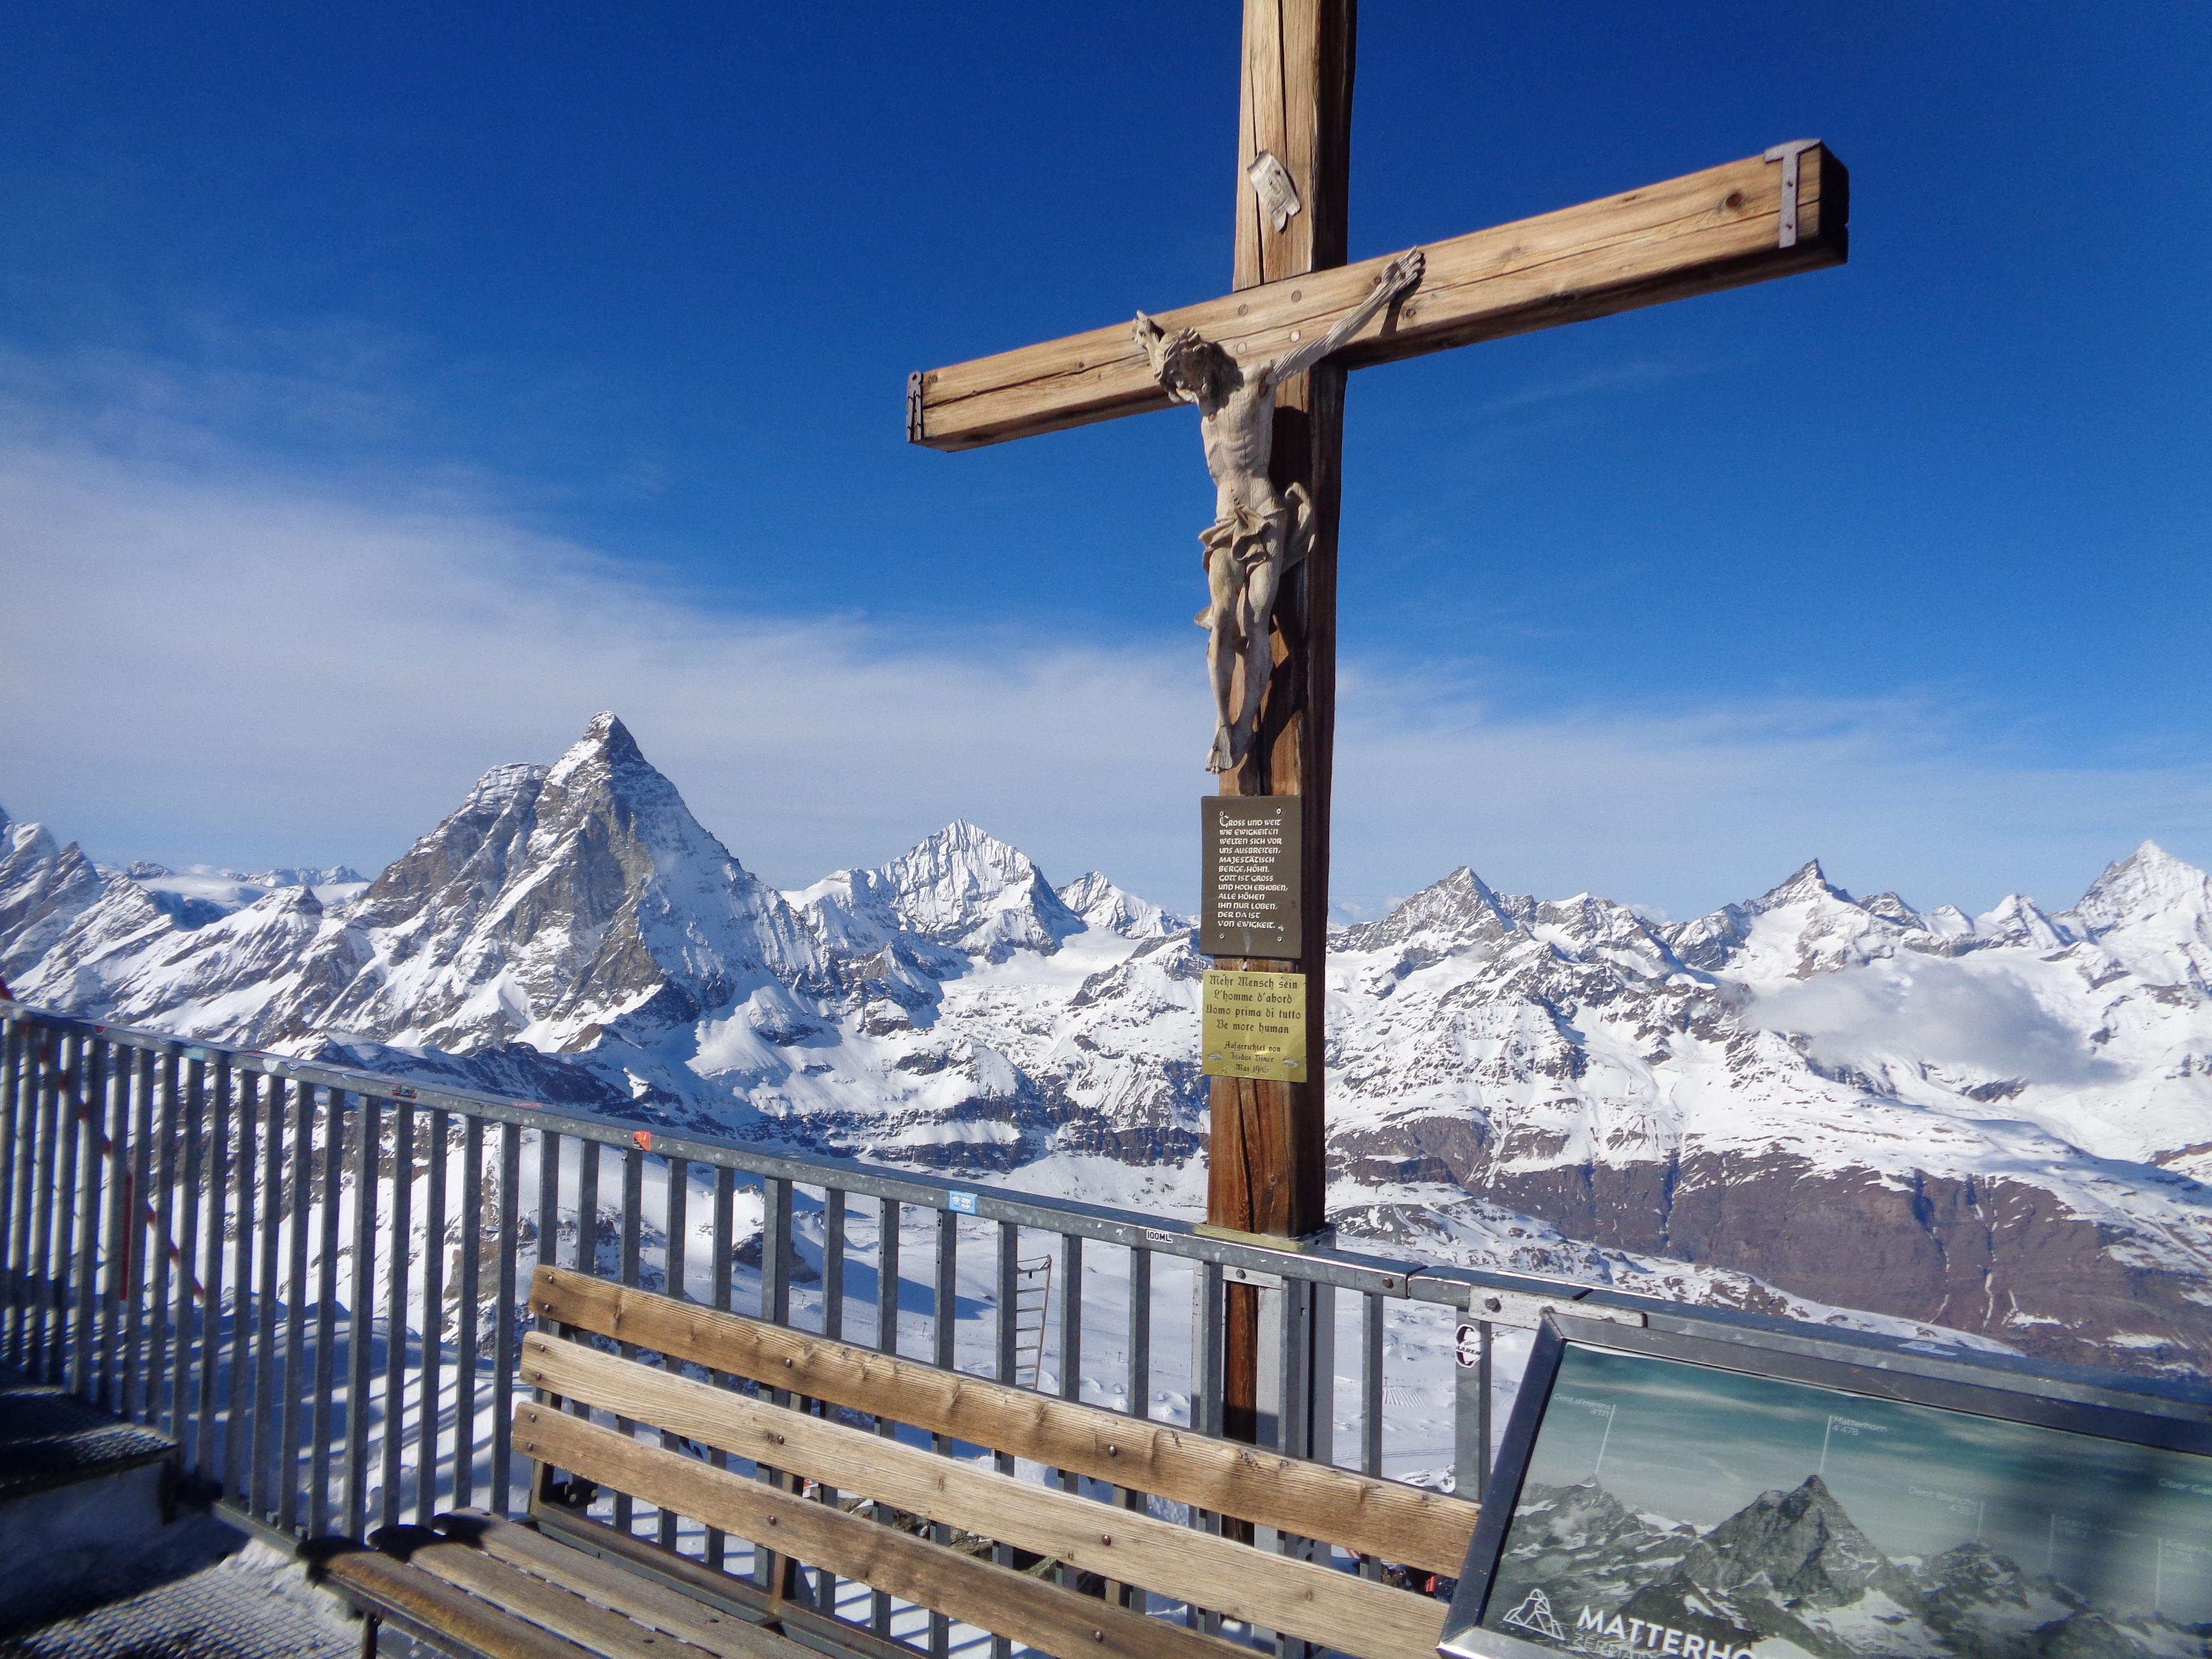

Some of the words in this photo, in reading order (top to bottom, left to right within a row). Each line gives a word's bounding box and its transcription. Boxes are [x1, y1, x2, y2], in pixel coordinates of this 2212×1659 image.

[1220, 816, 1245, 827] GROSS
[1238, 892, 1264, 900] HÖHEN
[1209, 975, 1233, 989] Mehr
[1238, 977, 1274, 990] Mensch
[1235, 1006, 1260, 1018] prima
[1266, 1008, 1274, 1018] di
[1279, 1010, 1301, 1019] tutto
[1217, 1019, 1228, 1029] Be
[1259, 1022, 1288, 1034] human
